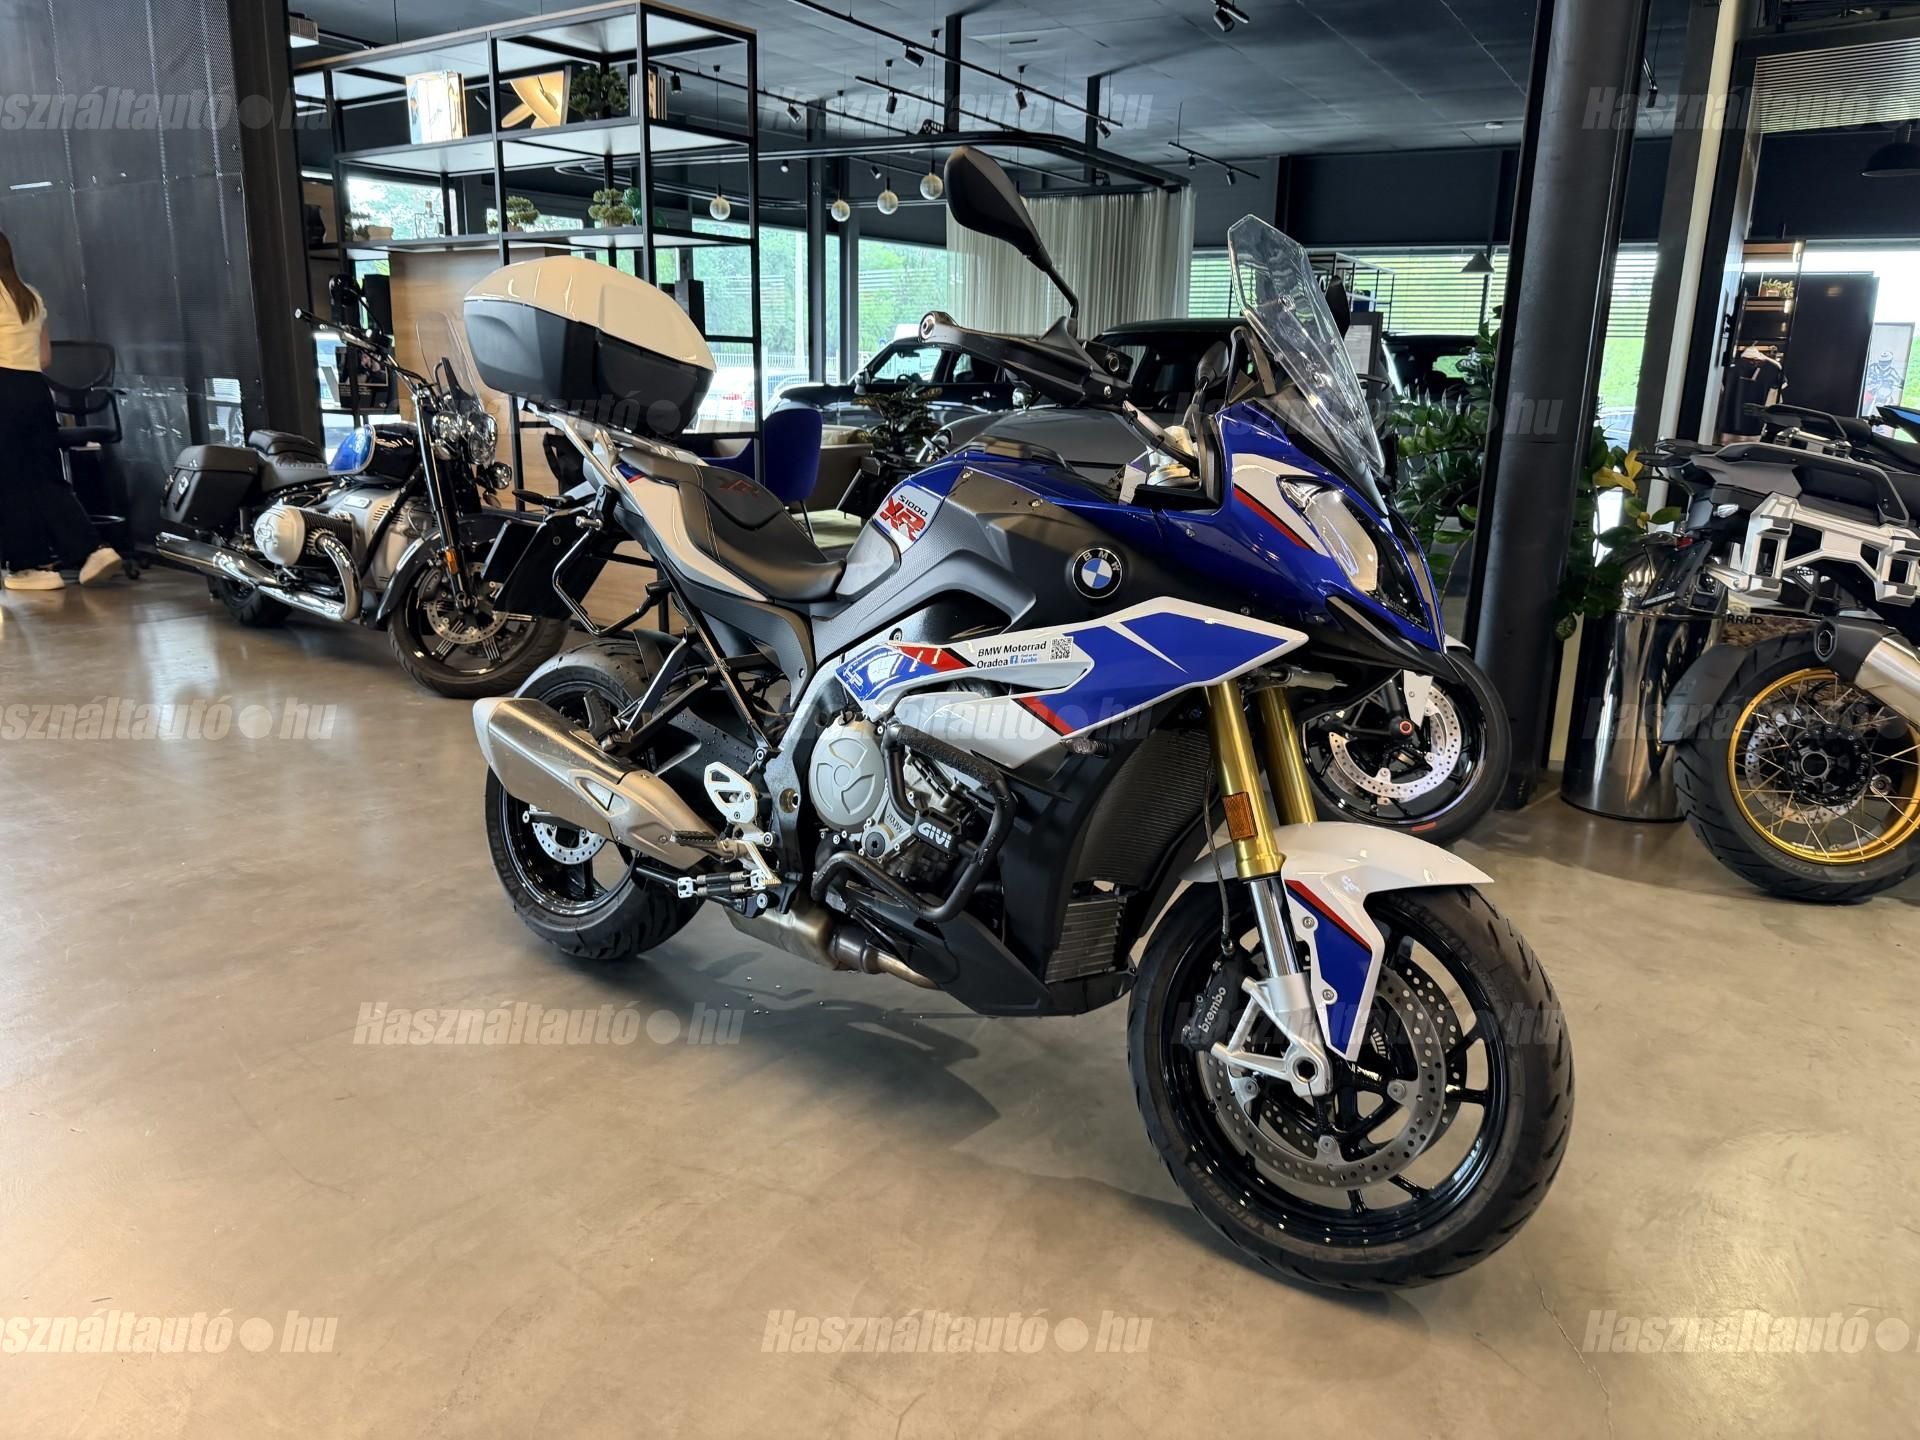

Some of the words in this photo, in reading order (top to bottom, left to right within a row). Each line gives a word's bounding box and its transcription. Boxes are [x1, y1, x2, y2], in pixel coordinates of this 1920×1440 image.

[1727, 614, 1765, 625] RRAD
[978, 645, 1002, 657] BMW
[1003, 641, 1047, 654] Motorrad
[976, 658, 1009, 669] Oradea
[917, 821, 953, 849] GIVI
[1198, 986, 1227, 1034] brembo
